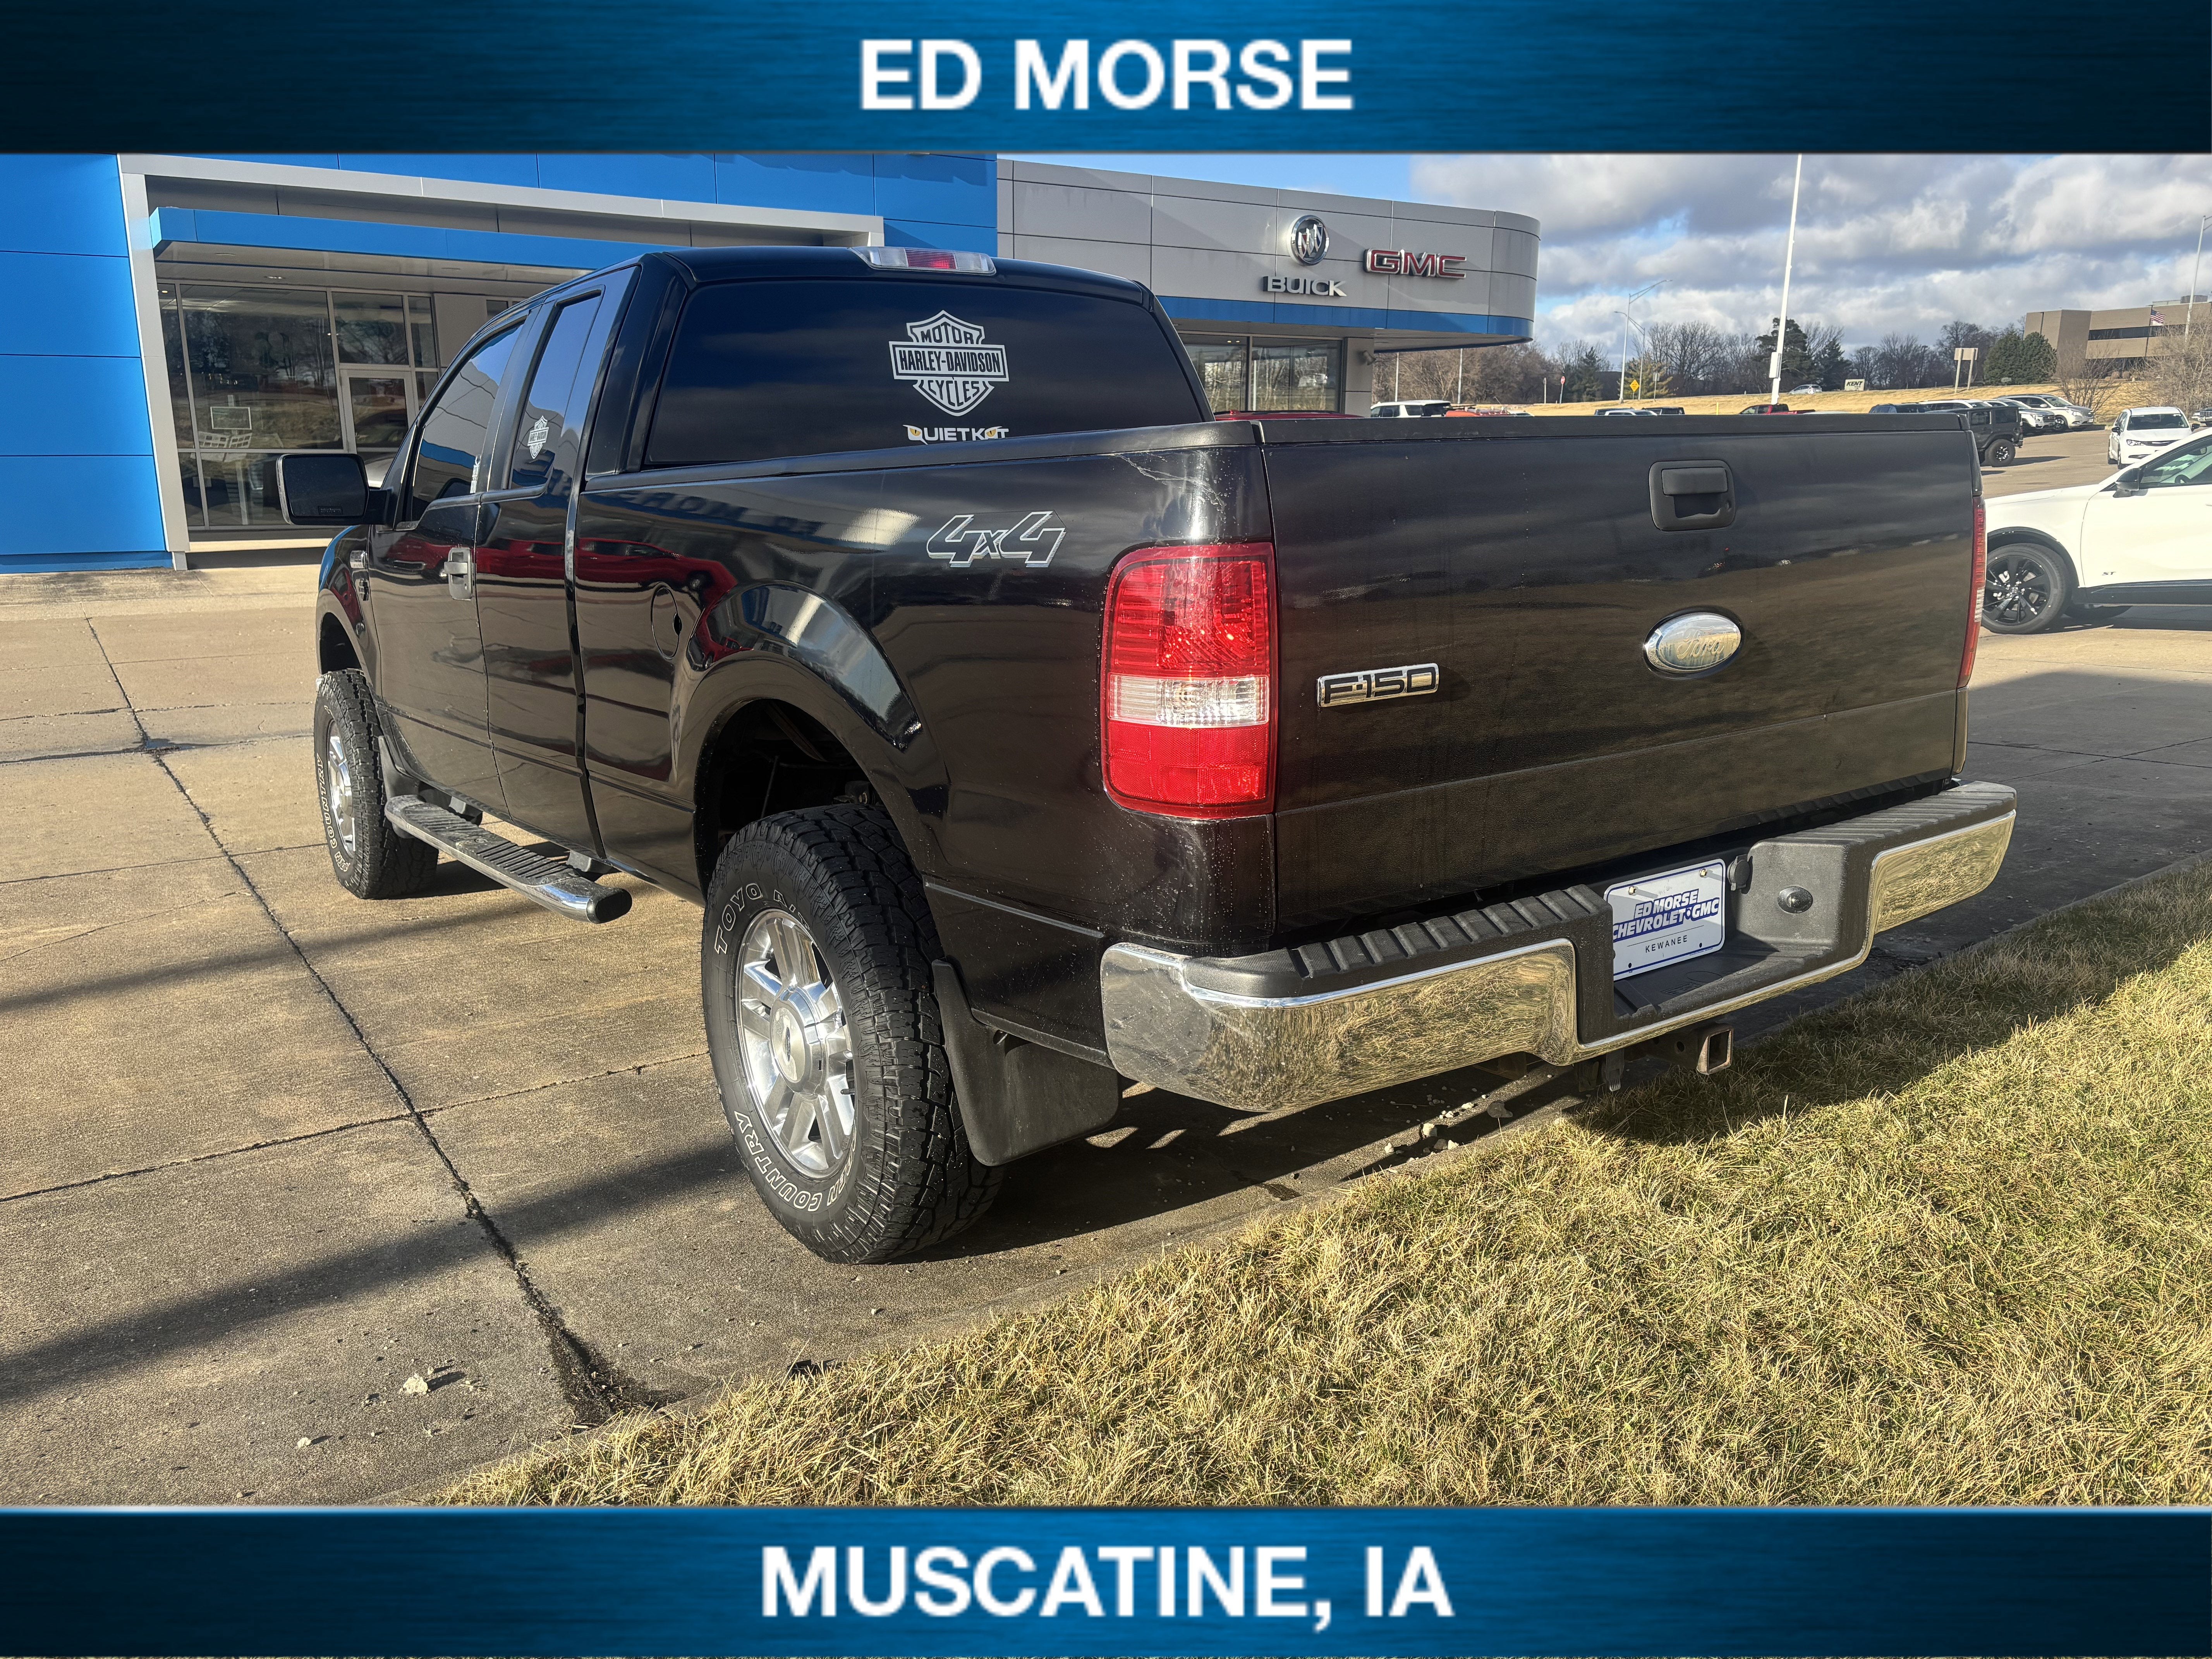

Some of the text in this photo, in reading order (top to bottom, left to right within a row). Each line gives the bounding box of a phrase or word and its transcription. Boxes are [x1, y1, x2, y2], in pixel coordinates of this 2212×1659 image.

[1363, 248, 1467, 278] GMC
[1263, 276, 1347, 297] BUICK
[921, 322, 974, 344] MOTOR
[899, 350, 1001, 372] HARLEY-DAVIDSON
[927, 379, 980, 407] CYCLES
[1677, 626, 1726, 660] Ford
[1324, 666, 1436, 704] F-150
[317, 753, 337, 849] COUNTRY
[714, 883, 762, 955] TOYO
[1634, 890, 1698, 919] ED MORSE
[1646, 935, 1688, 953] KEWANEE
[734, 1111, 823, 1212] COUNTRY
